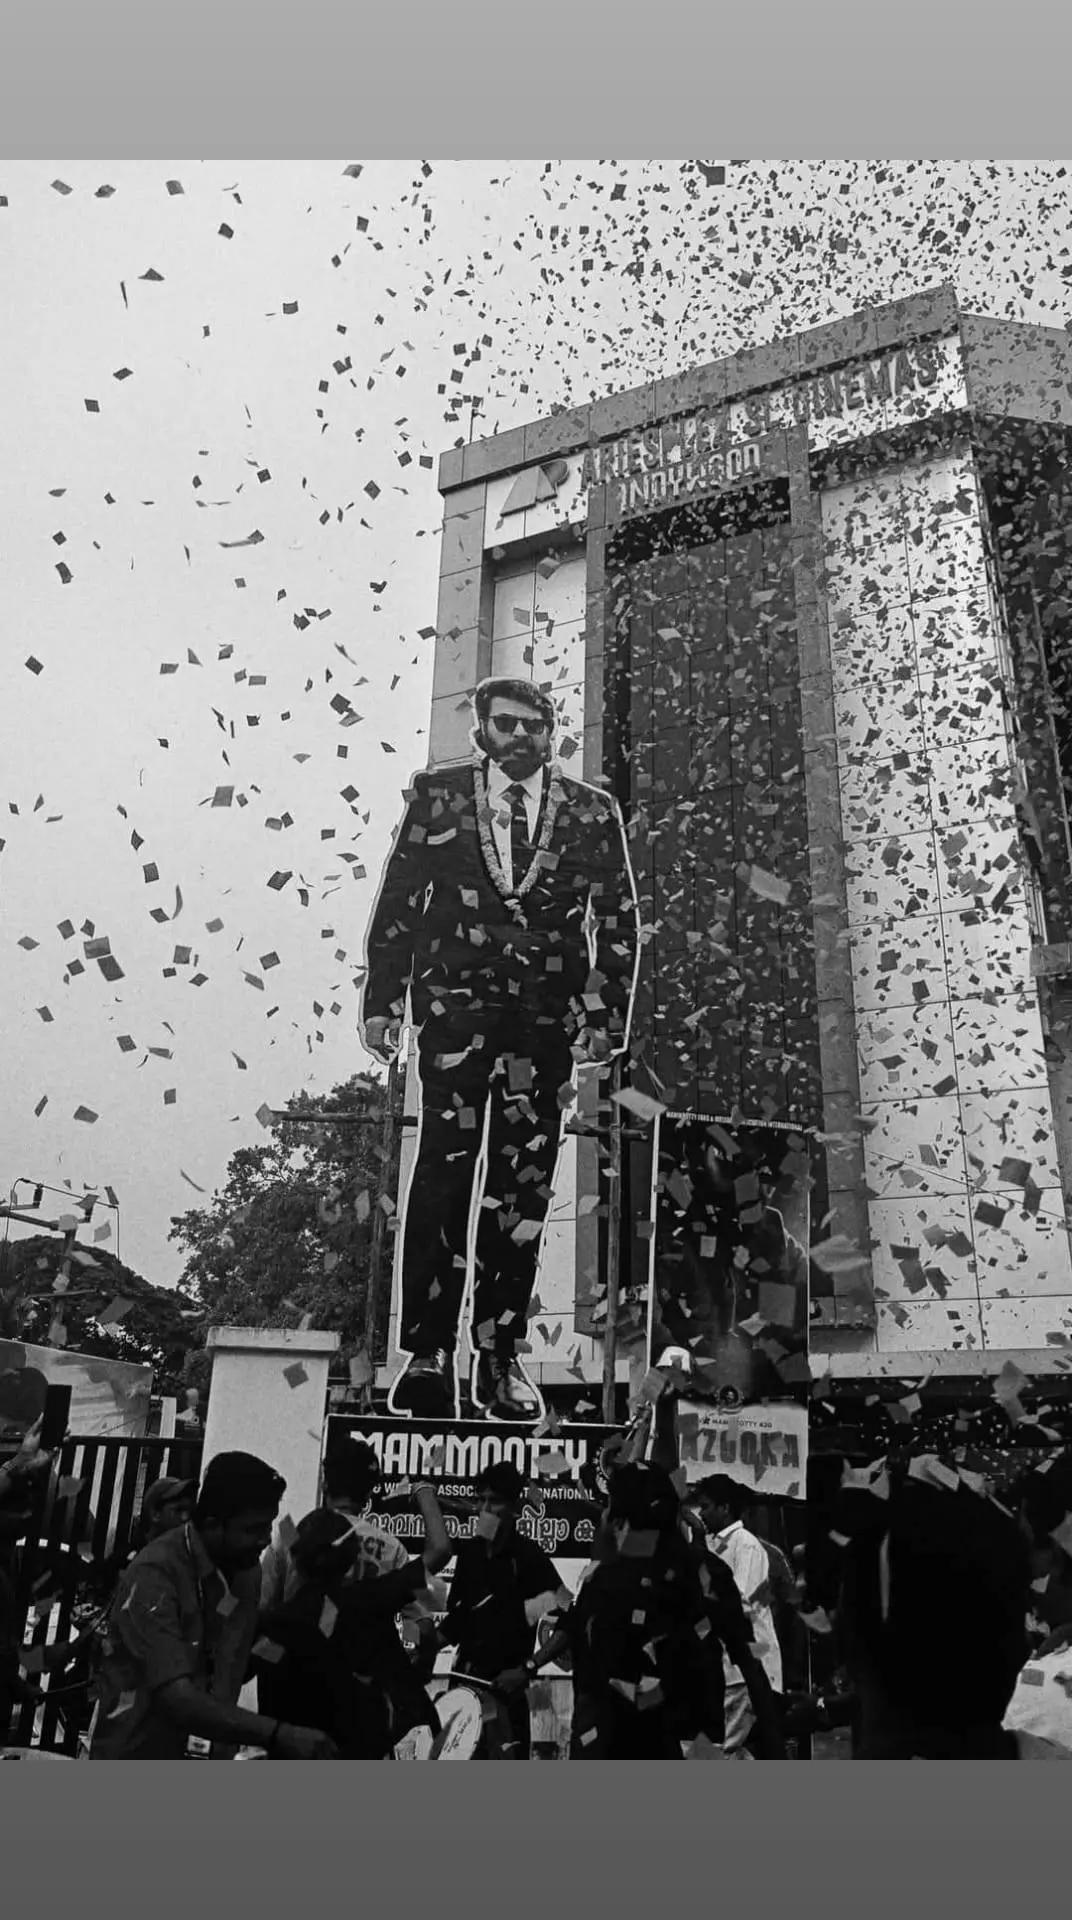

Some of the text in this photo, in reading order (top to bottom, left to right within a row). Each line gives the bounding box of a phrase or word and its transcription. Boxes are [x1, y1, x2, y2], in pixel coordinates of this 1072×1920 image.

[580, 427, 660, 490] ARIES
[791, 346, 938, 423] CINEMAS
[349, 1430, 587, 1480] MAMMOOTTY
[681, 1428, 800, 1468] AZOOKA
